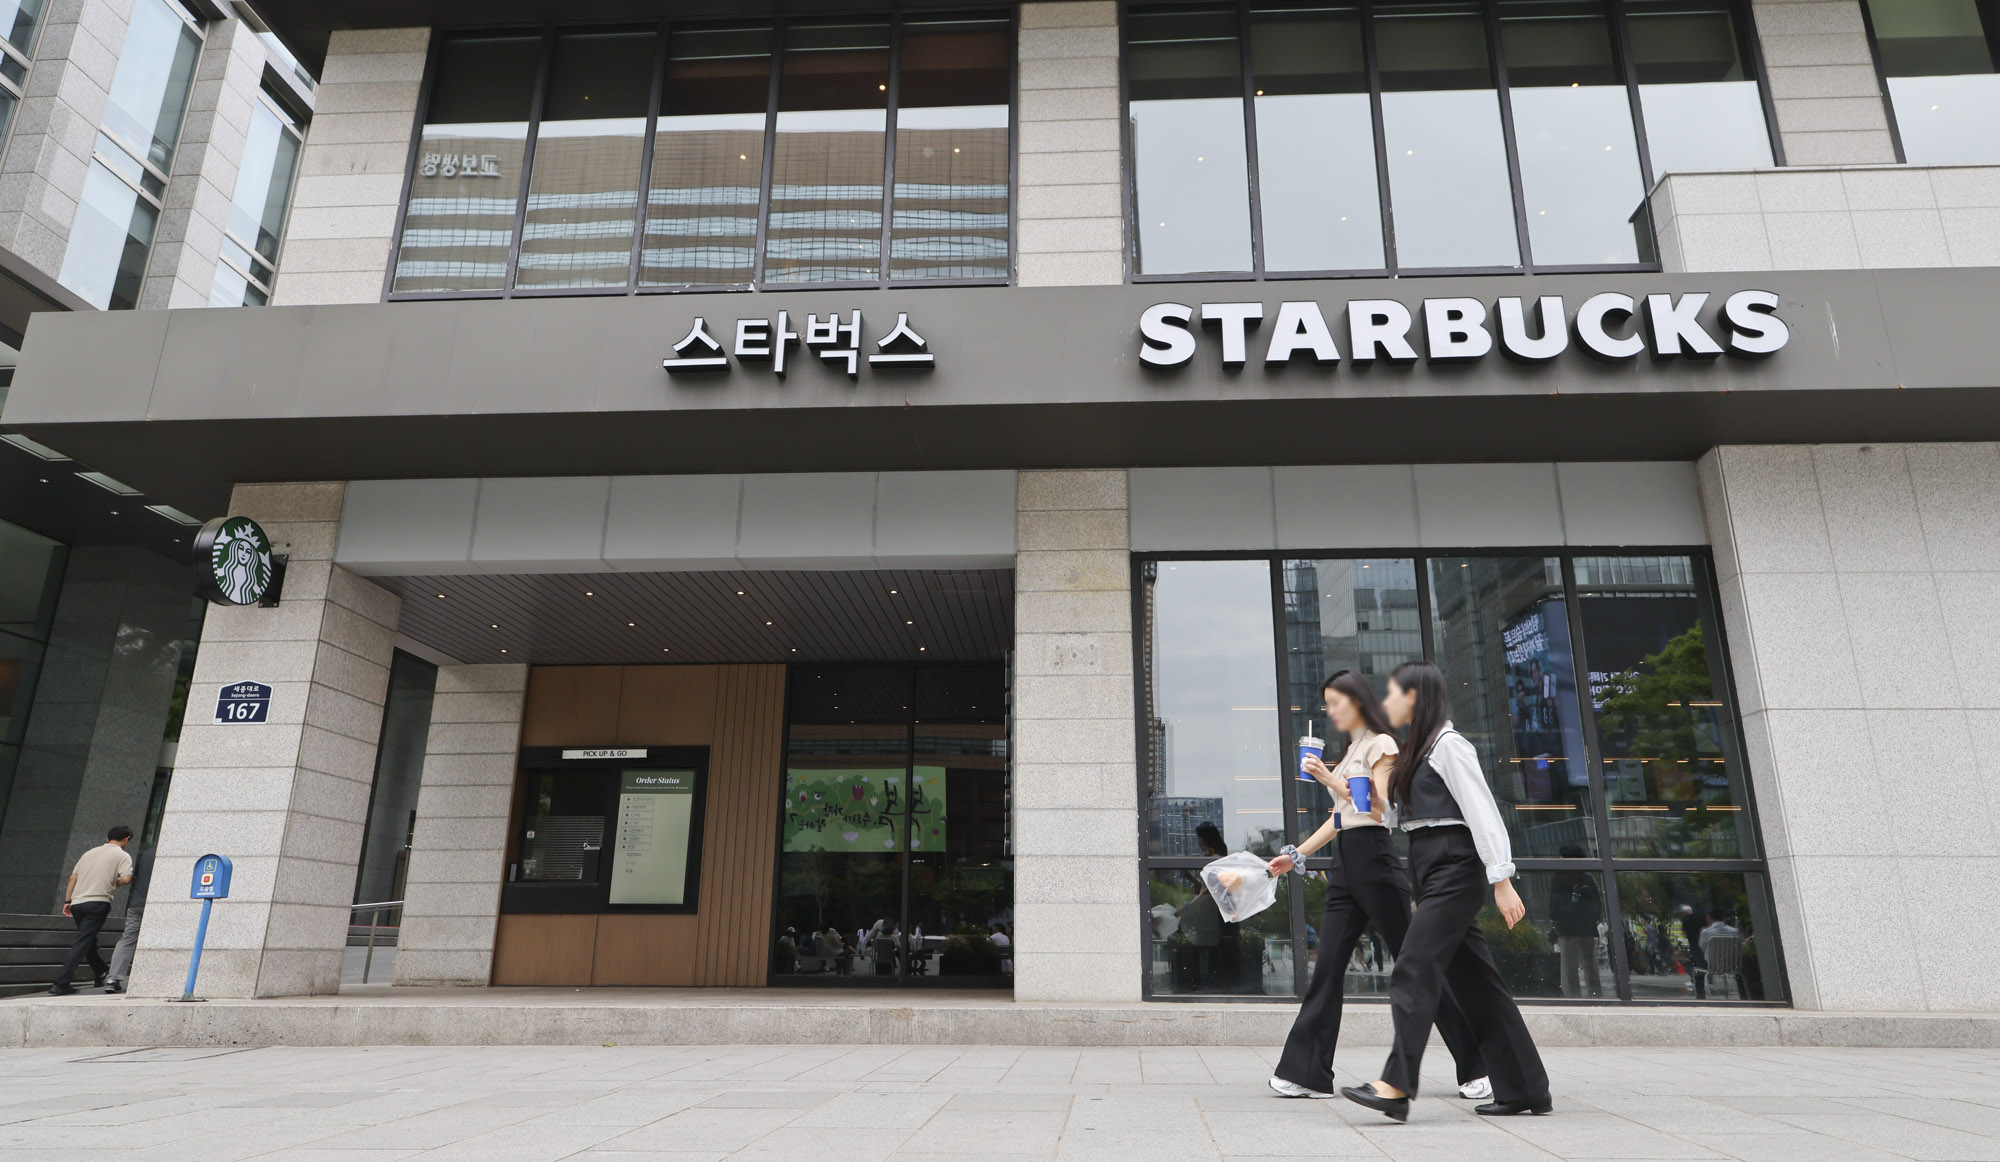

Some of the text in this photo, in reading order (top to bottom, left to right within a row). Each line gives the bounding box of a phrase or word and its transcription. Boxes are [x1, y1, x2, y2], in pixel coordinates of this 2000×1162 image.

[1138, 290, 1790, 369] STARBUCKS
[662, 309, 934, 377] 스타벅스
[233, 685, 260, 693] 세종대로
[226, 702, 260, 720] 167
[636, 776, 680, 784] Order Status
